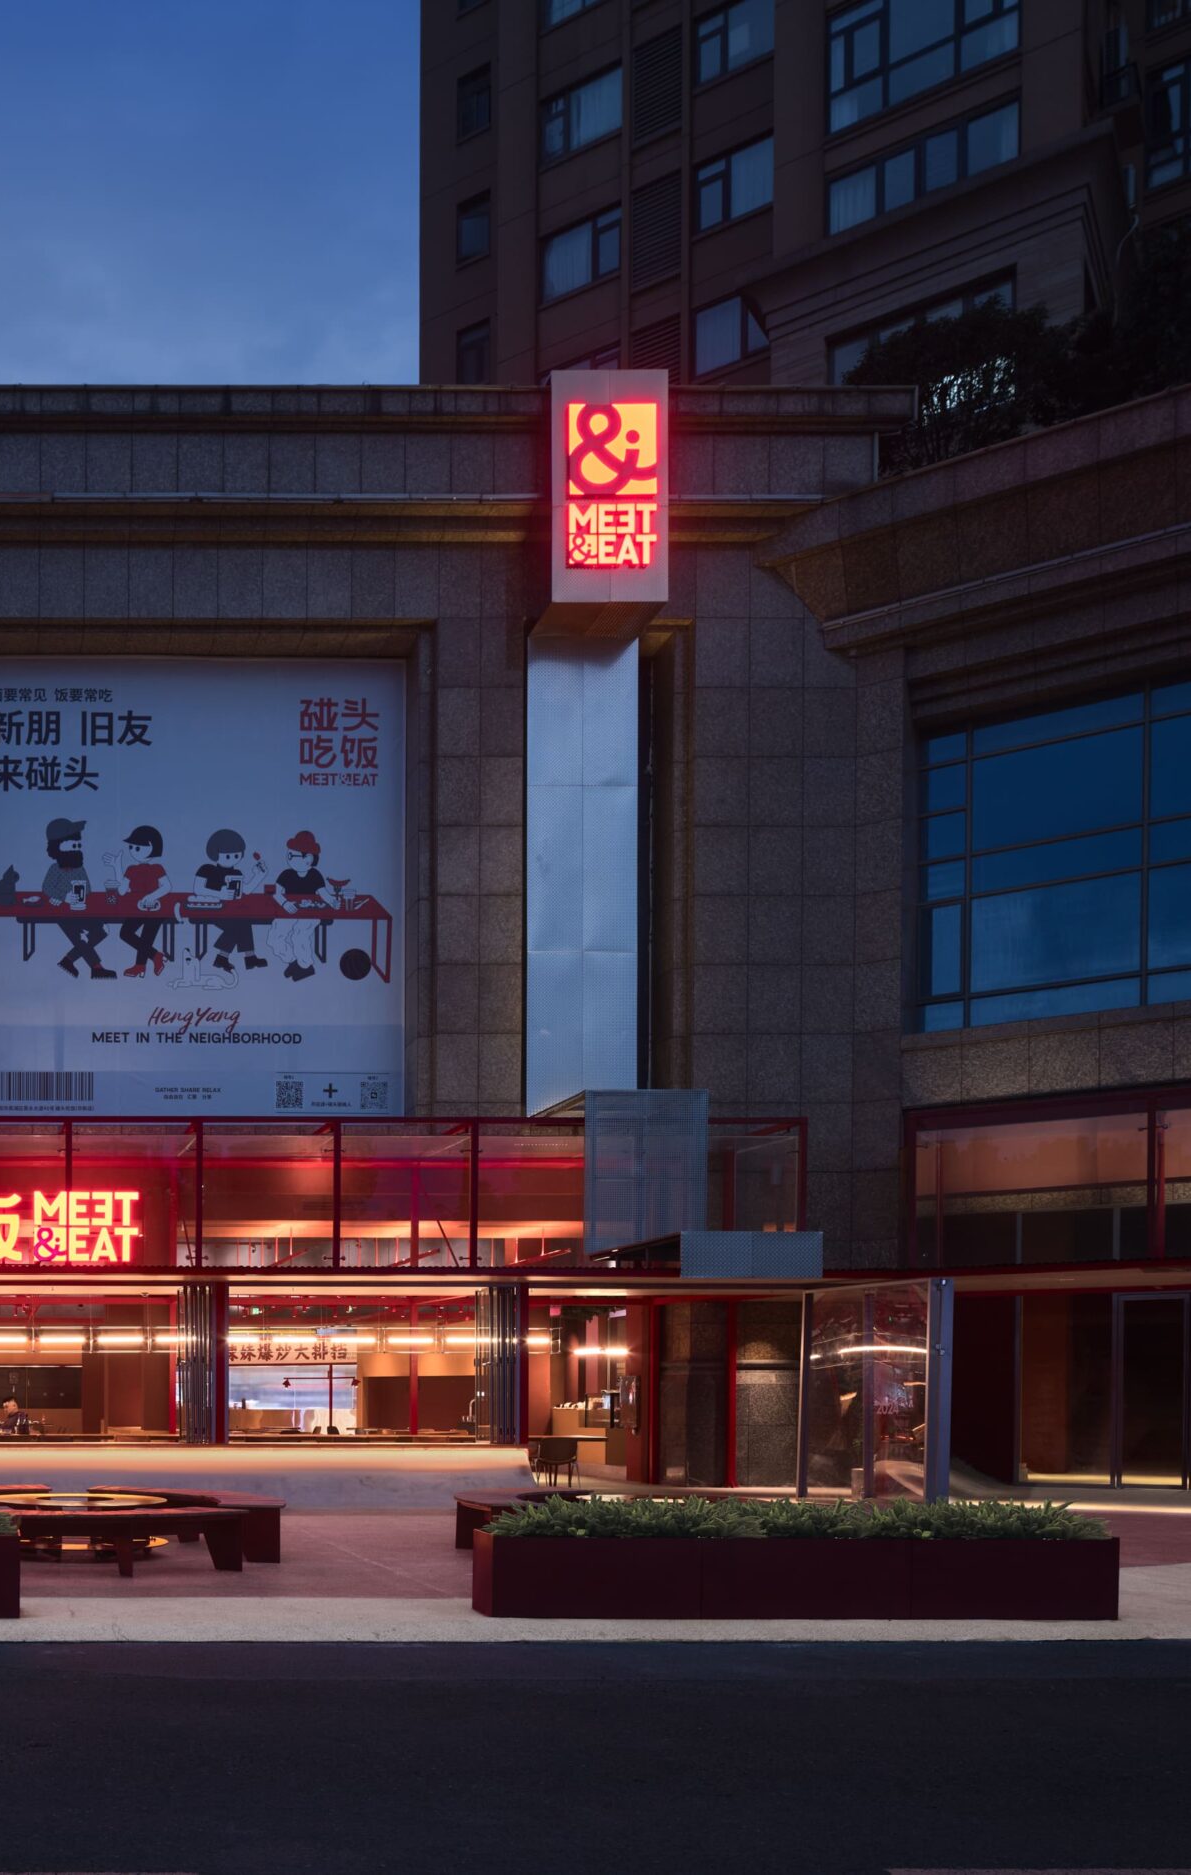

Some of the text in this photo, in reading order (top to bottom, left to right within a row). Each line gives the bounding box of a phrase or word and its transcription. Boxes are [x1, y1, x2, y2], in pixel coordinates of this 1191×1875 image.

[54, 687, 113, 703] 饭要常吃
[80, 710, 152, 747] 旧友
[300, 697, 379, 732] 碰头
[300, 735, 379, 769] 吃饭
[91, 1032, 302, 1045] MEET IN THE NEIGHBORHOOD
[33, 1191, 140, 1227] MEET
